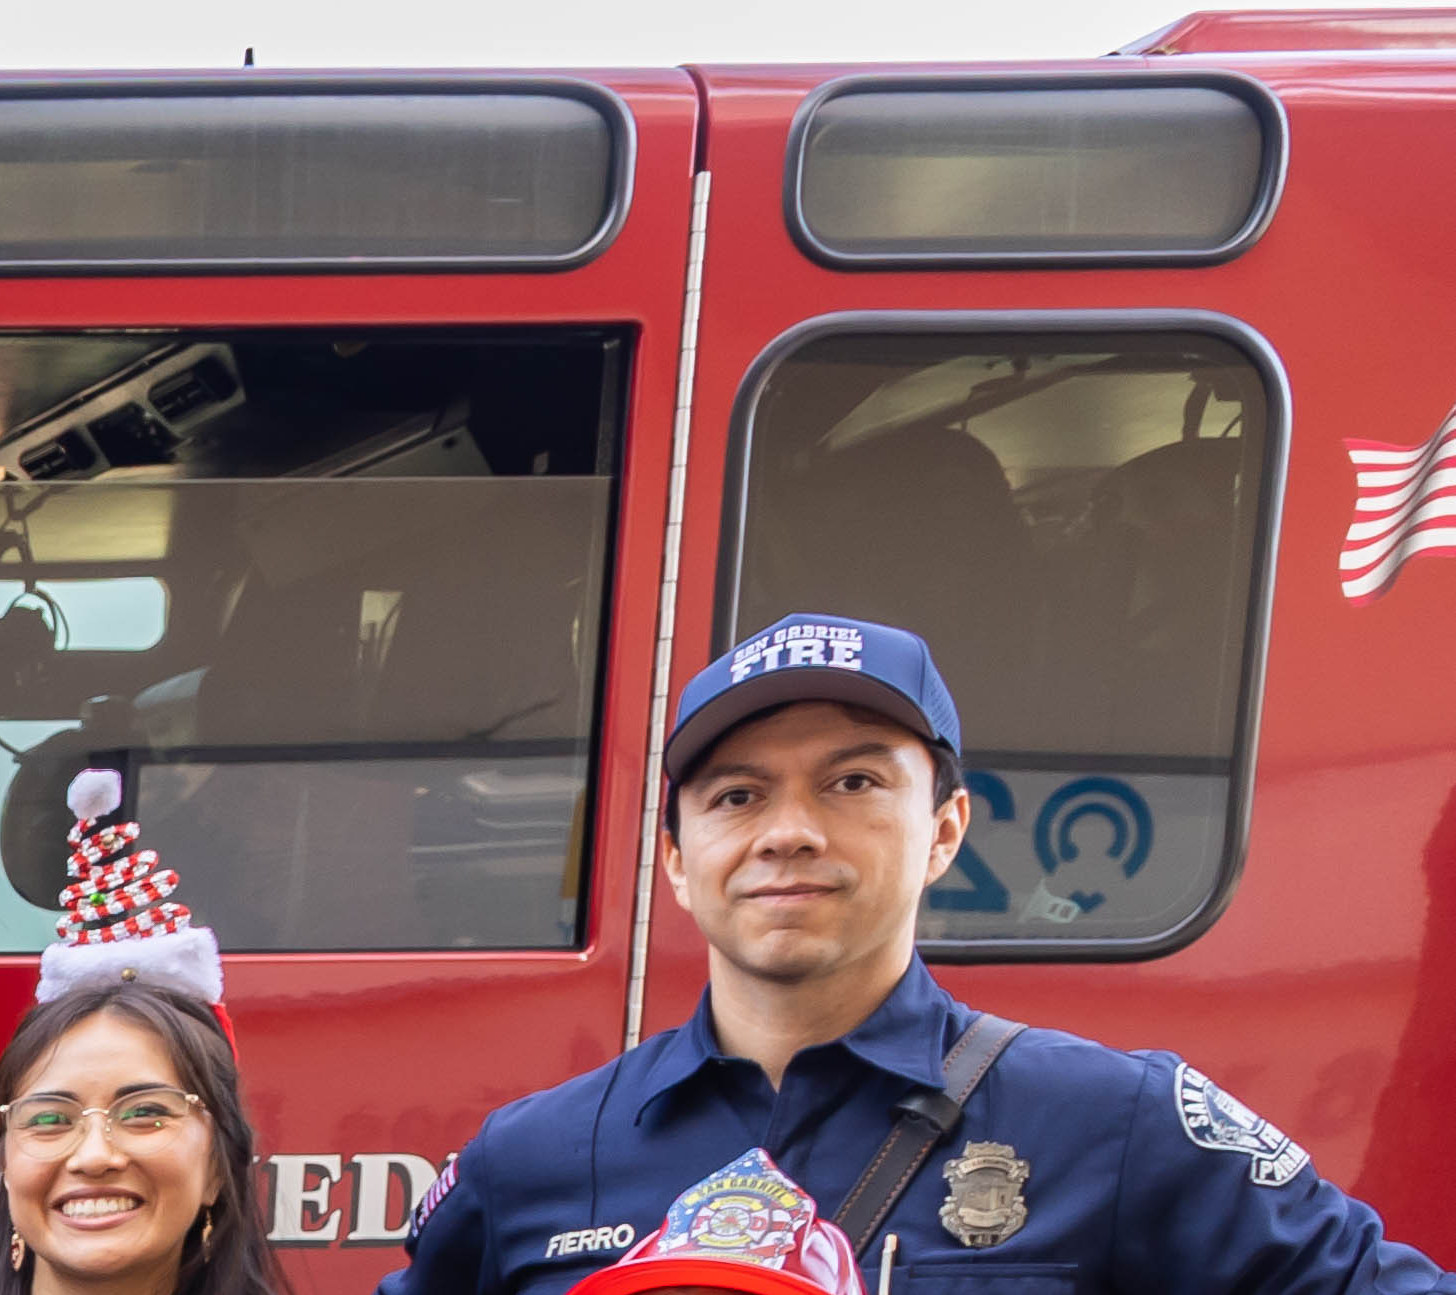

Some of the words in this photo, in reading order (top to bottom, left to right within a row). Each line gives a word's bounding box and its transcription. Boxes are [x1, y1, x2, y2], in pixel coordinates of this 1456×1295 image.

[731, 638, 863, 684] FIRE
[734, 636, 770, 663] SAN
[774, 625, 862, 643] GABRIEL
[545, 1223, 635, 1258] FIERRO
